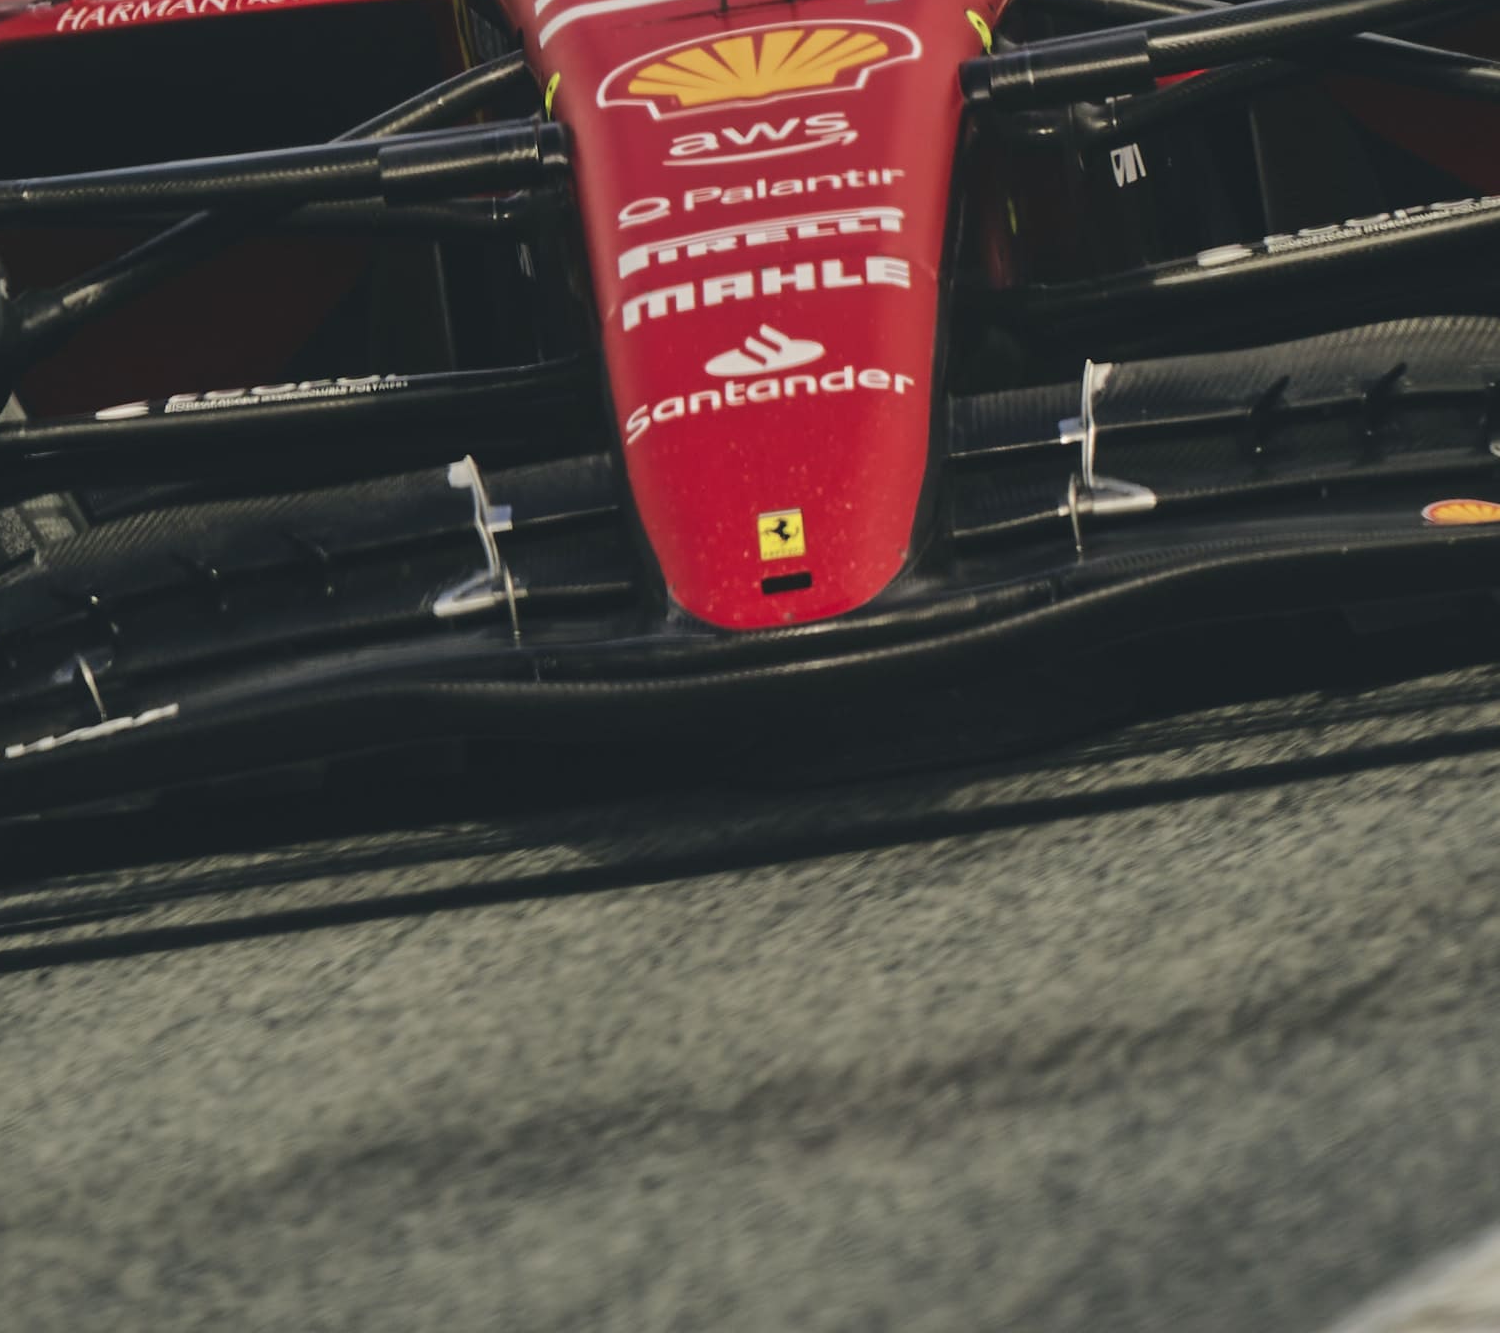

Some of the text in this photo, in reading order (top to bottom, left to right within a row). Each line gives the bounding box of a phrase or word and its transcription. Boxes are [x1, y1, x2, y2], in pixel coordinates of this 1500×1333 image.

[669, 111, 851, 159] aws
[684, 167, 907, 211] Palantir
[618, 206, 904, 280] PIRELLI
[622, 255, 911, 332] MAHLE
[626, 365, 916, 445] Santander
